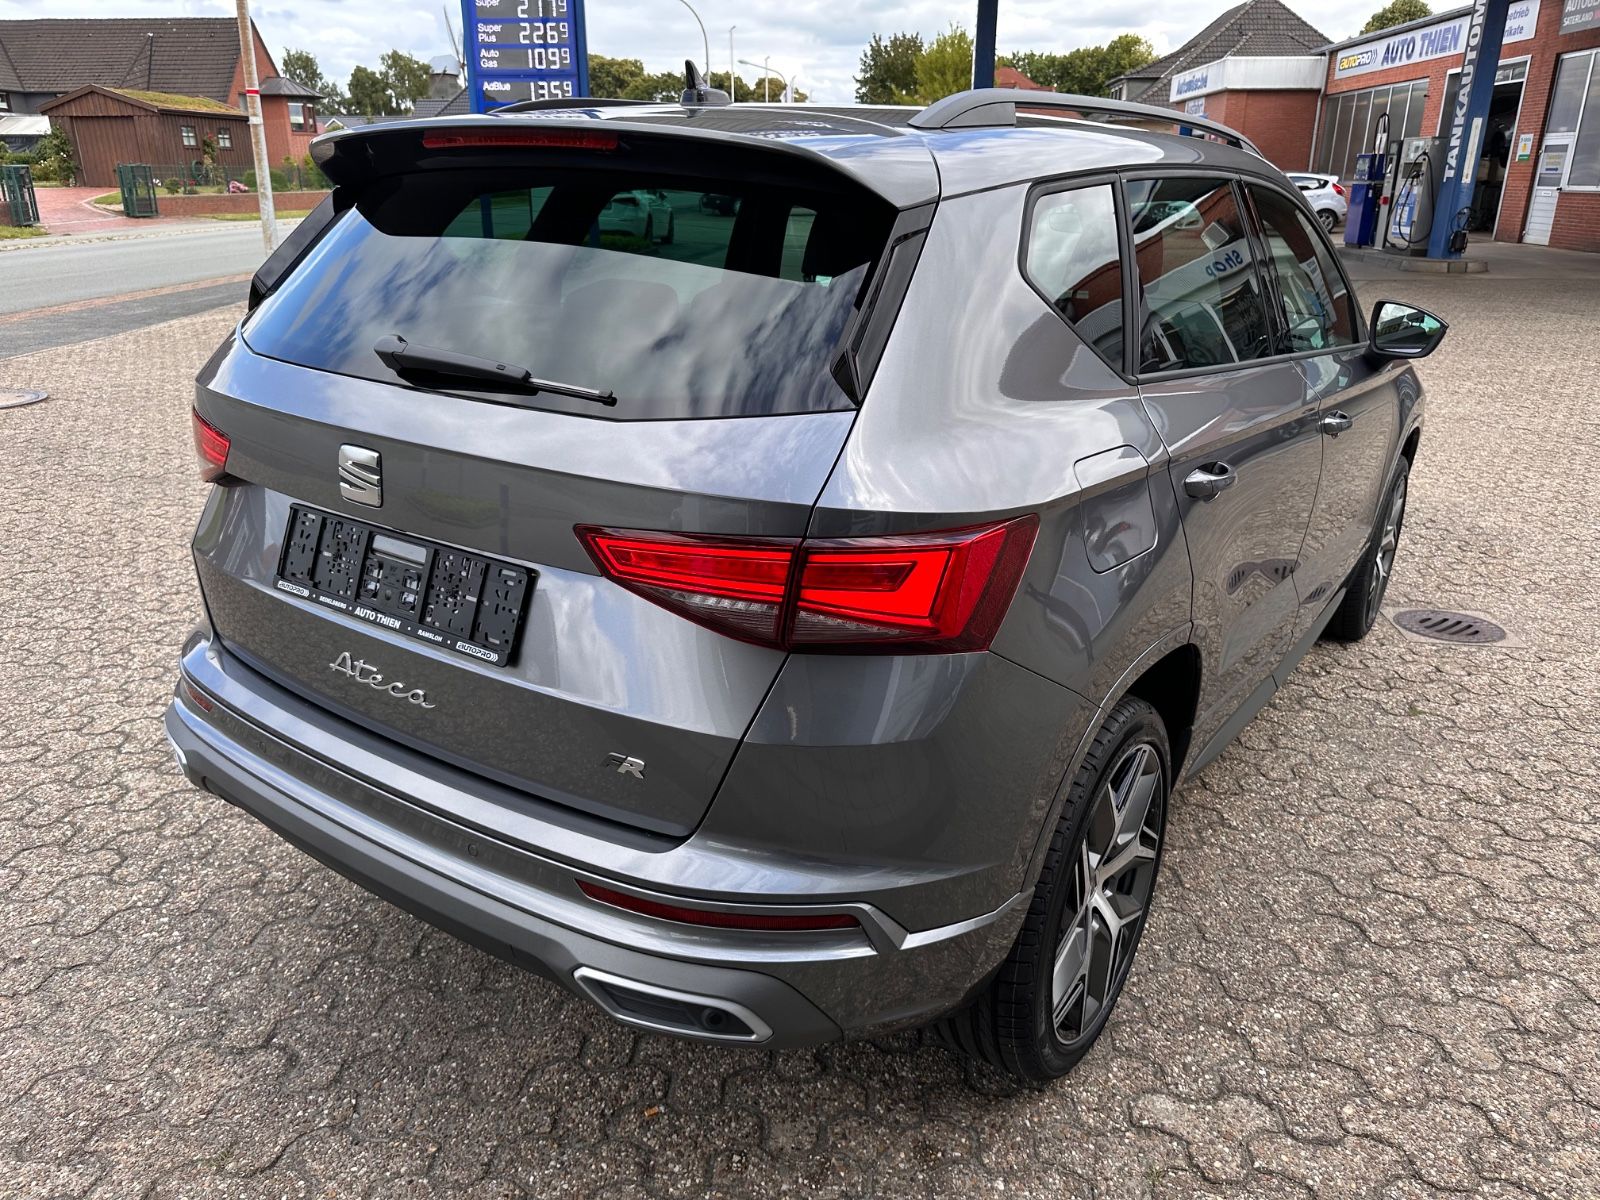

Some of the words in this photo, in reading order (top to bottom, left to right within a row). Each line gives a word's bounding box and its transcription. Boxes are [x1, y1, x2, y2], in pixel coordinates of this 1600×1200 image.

[475, 0, 499, 8] Super
[477, 22, 502, 33] Super
[478, 33, 497, 42] Plus
[1381, 36, 1415, 66] AUTO
[1419, 23, 1462, 58] THIEN
[480, 48, 499, 58] Auto
[480, 59, 498, 68] Gas
[483, 82, 511, 91] AdBlue
[354, 606, 376, 621] AUTO
[376, 613, 401, 630] THIEN
[329, 651, 436, 709] Ateca
[603, 751, 646, 780] FR
